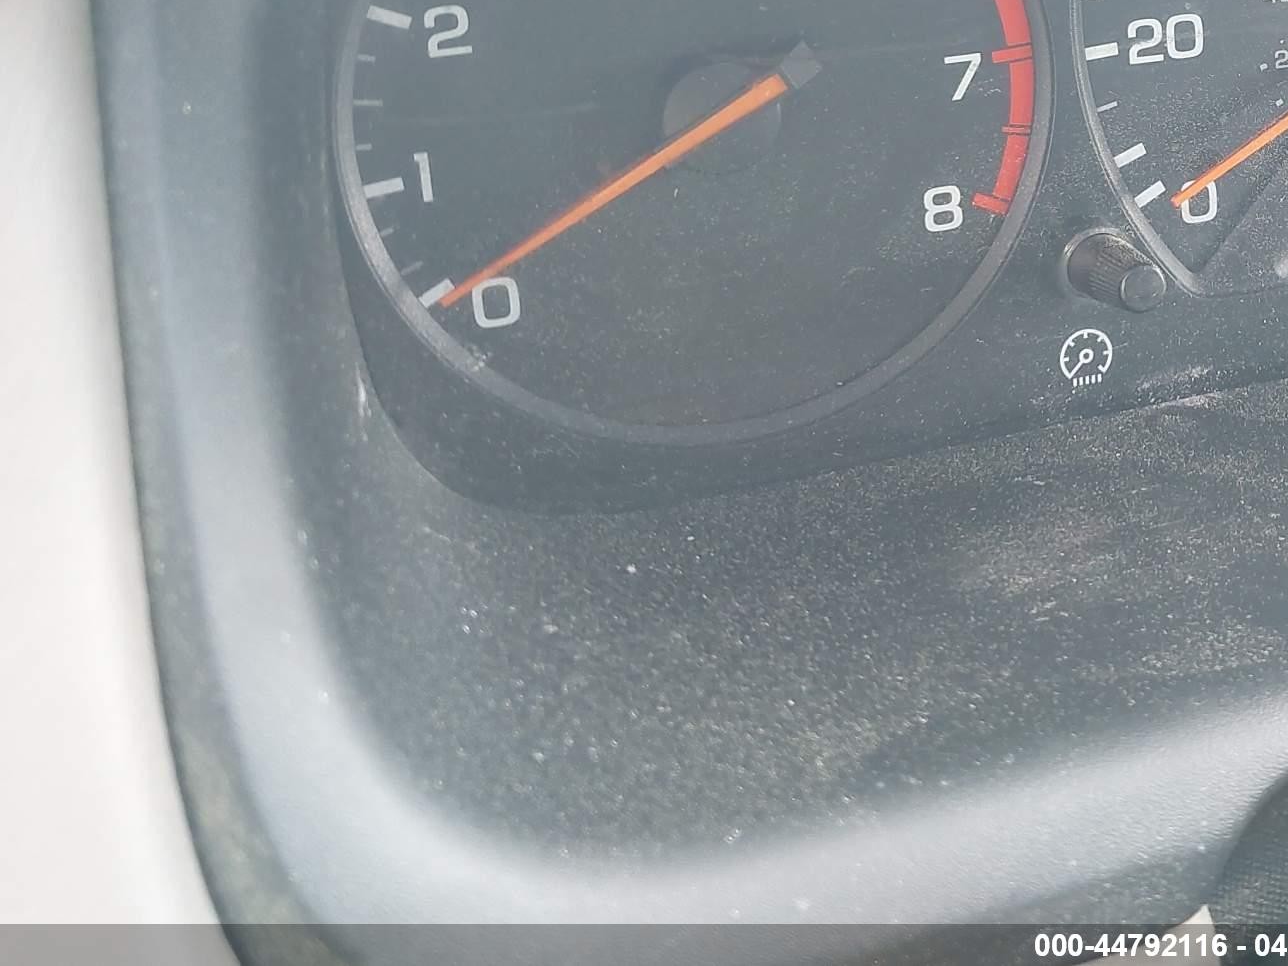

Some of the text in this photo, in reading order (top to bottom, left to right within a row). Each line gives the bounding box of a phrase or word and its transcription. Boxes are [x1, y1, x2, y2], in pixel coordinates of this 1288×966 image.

[422, 4, 473, 58] 2
[1127, 13, 1204, 65] 20
[943, 53, 983, 101] 7
[413, 151, 433, 202] 1
[1181, 179, 1218, 224] 0
[922, 185, 965, 233] 8
[471, 276, 521, 329] 0
